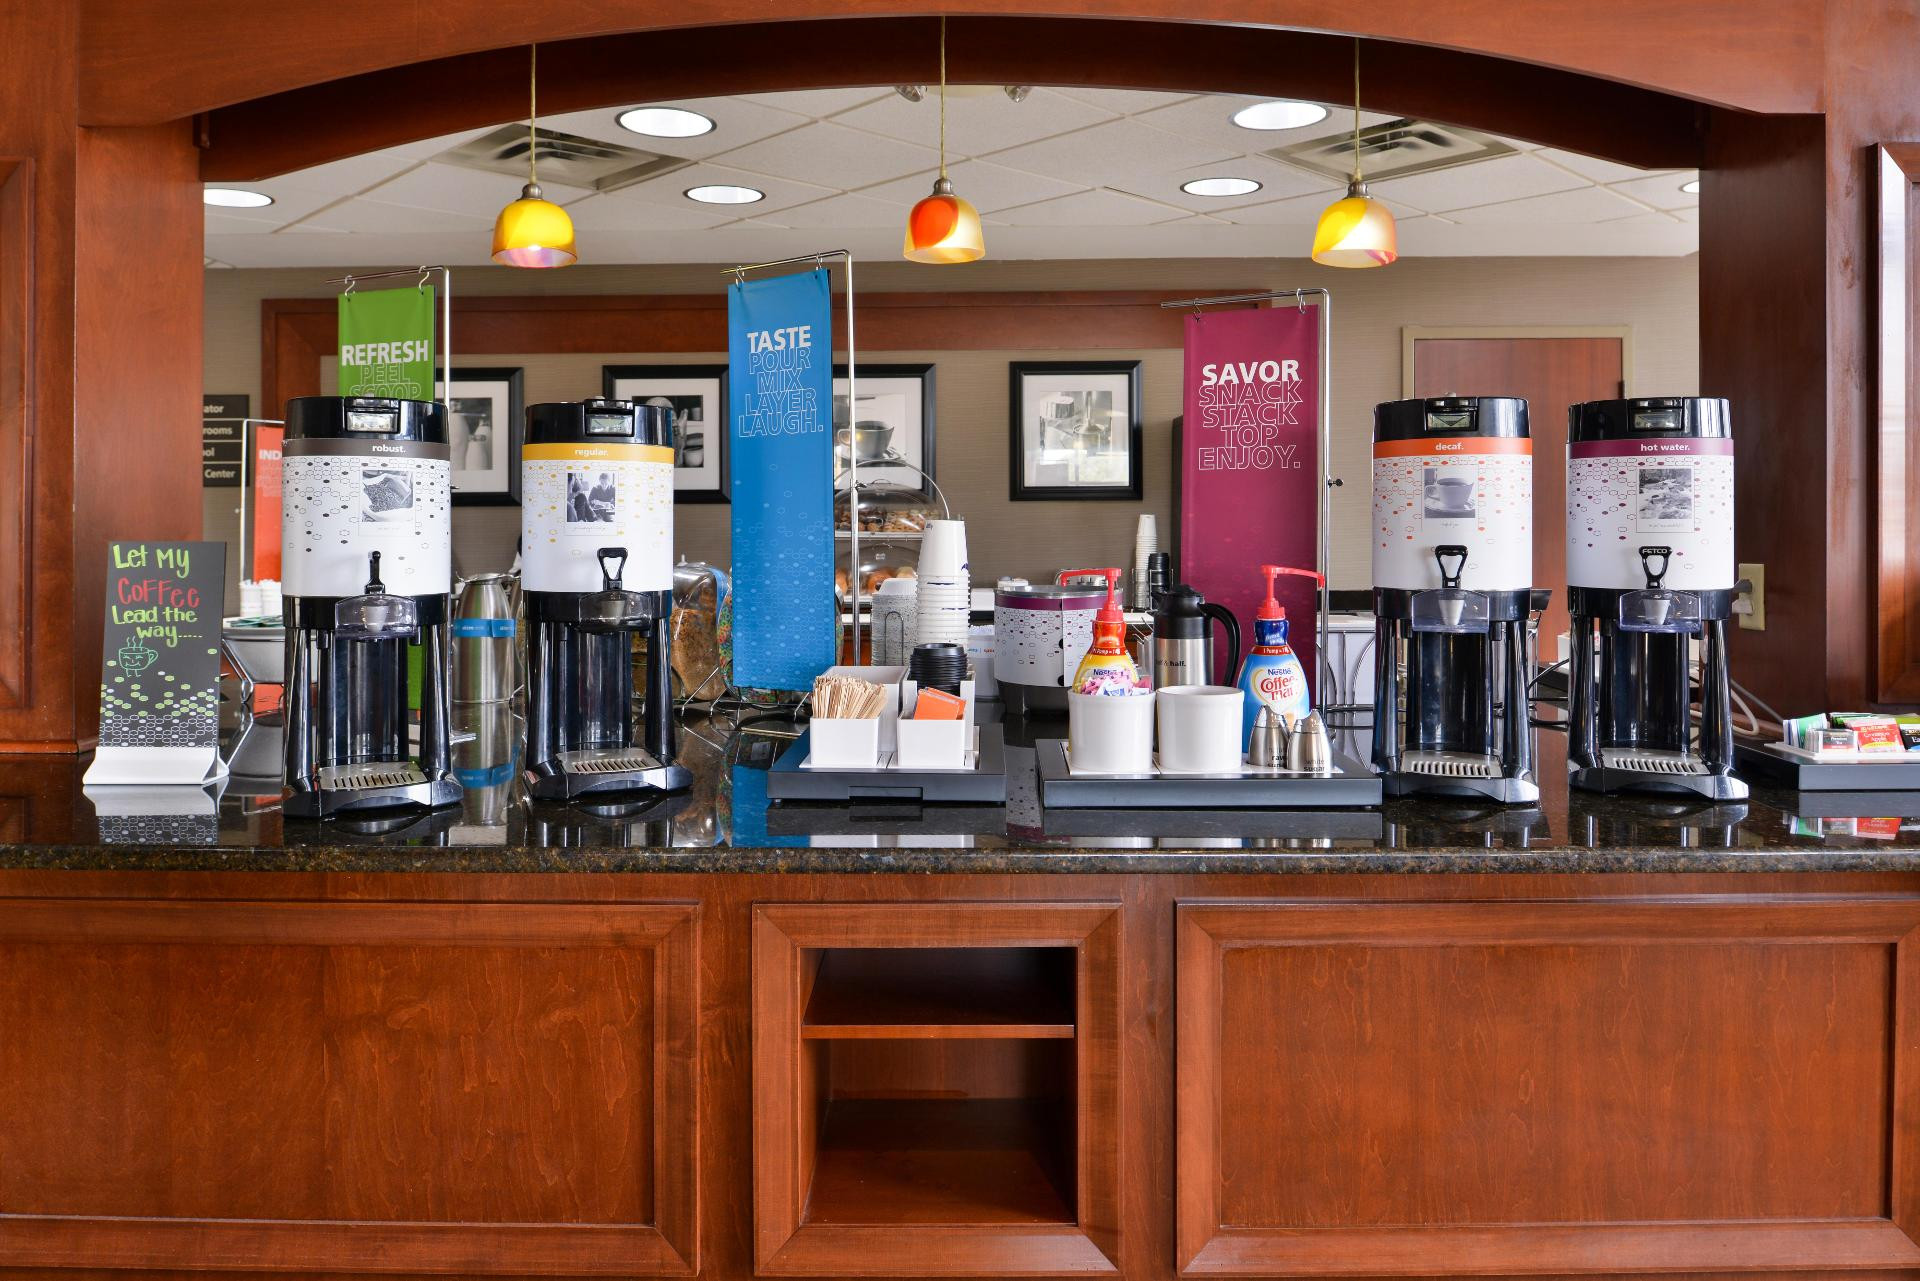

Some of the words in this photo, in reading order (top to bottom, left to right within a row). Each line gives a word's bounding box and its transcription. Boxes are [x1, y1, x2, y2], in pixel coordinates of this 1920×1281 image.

[747, 325, 812, 353] TASTE
[341, 339, 429, 366] REFRESH
[749, 346, 811, 374] POUR
[360, 362, 410, 386] PEEL
[757, 368, 803, 394] MIX
[1202, 359, 1300, 386] SAVOR
[745, 387, 817, 416] LAYER
[1198, 379, 1303, 407] SNACK
[738, 410, 824, 437] LAUGH.
[1202, 401, 1298, 428] STACK
[372, 444, 406, 453] robust.
[1220, 424, 1279, 448] TOP
[1435, 442, 1464, 451] decaf.
[1640, 443, 1658, 452] hot
[1660, 444, 1690, 452] water.
[574, 448, 609, 457] regular.
[1198, 445, 1301, 470] ENJOY.
[204, 468, 236, 478] Center
[112, 544, 148, 569] Let
[112, 605, 158, 625] Lead
[162, 606, 198, 623] the
